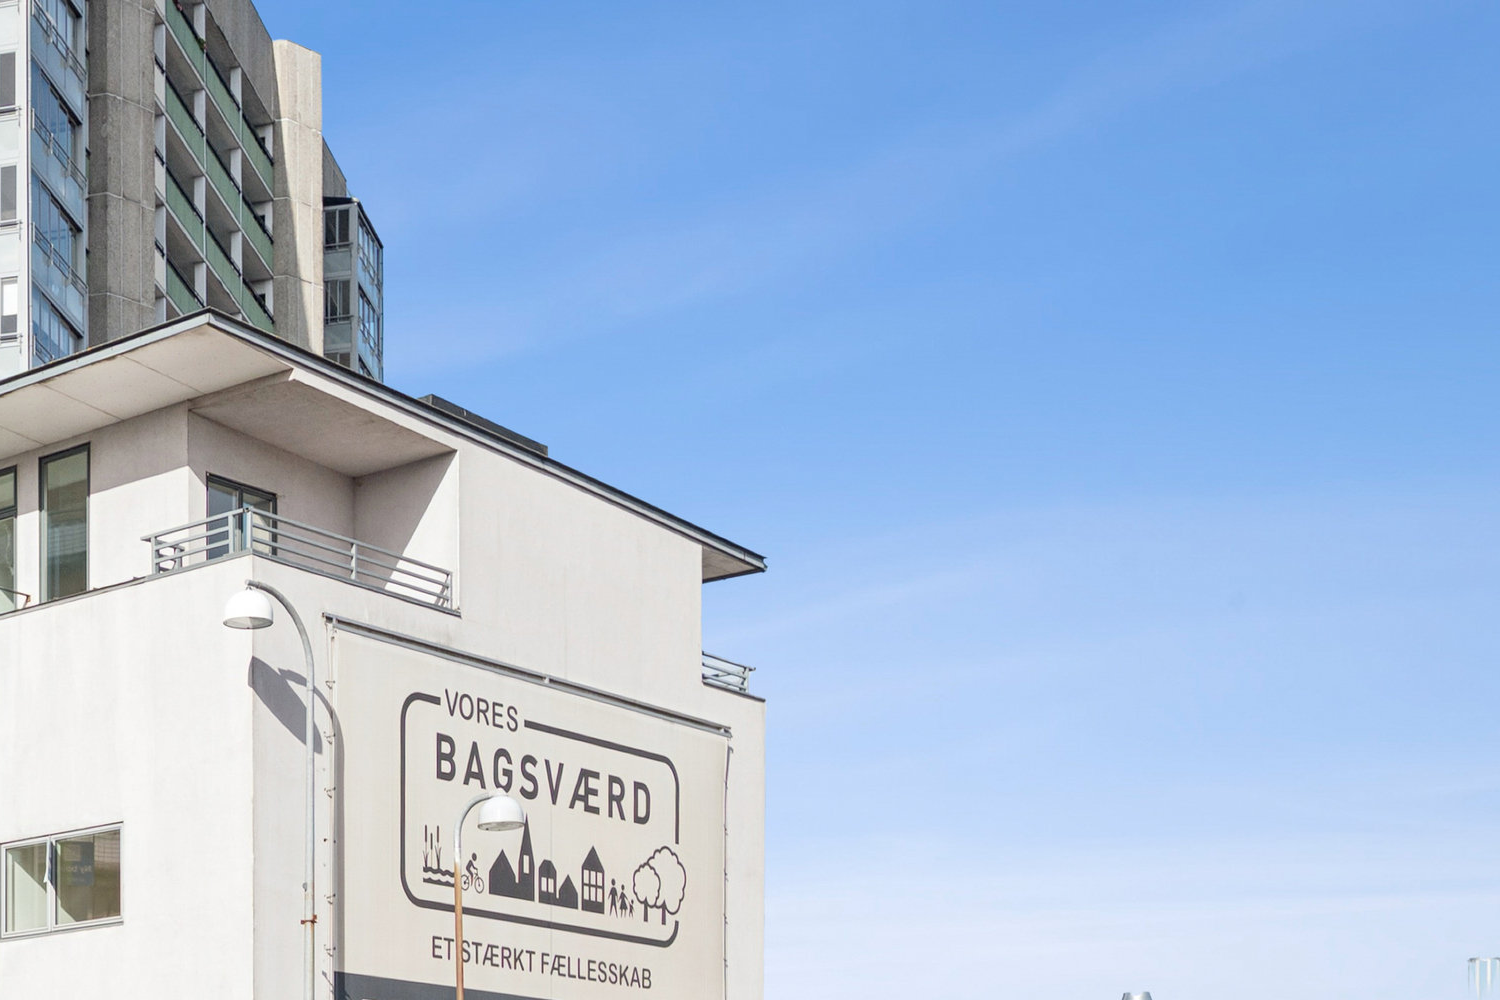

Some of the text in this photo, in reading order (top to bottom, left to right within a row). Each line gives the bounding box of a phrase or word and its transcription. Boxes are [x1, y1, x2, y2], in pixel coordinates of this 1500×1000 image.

[445, 688, 518, 733] VORES
[436, 732, 651, 825] BAGSVÆRD
[432, 935, 652, 989] ET STÆRKT FÆLLESSKAB
